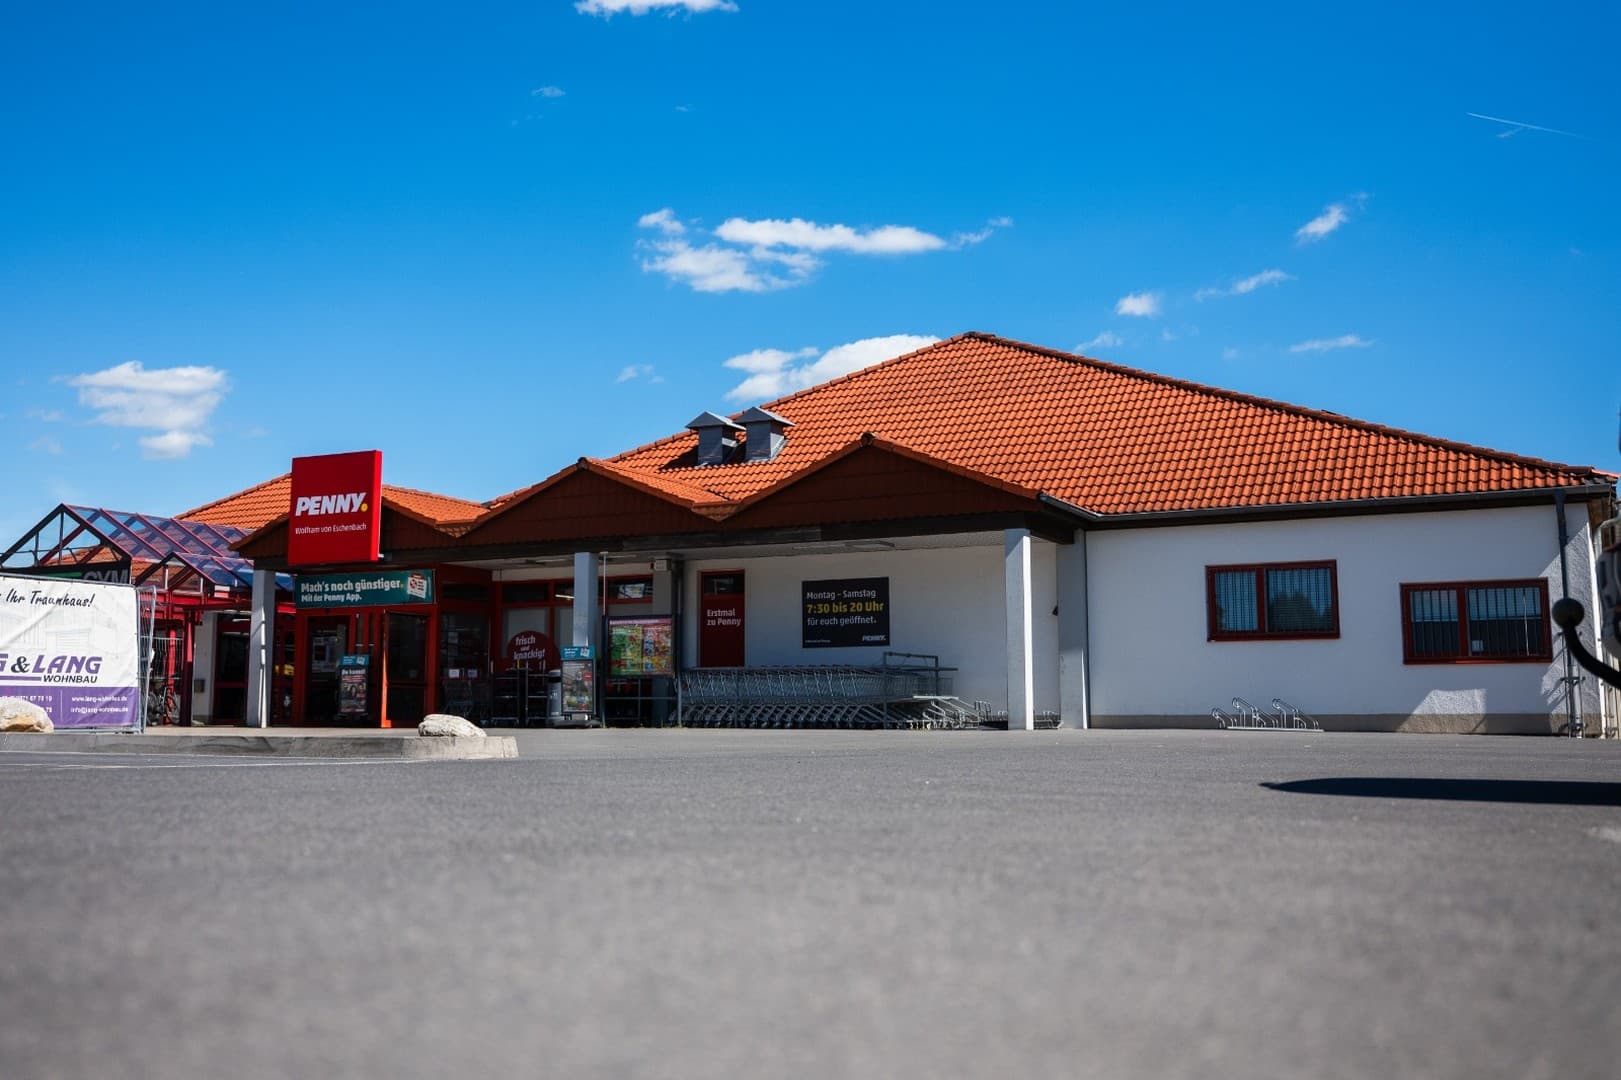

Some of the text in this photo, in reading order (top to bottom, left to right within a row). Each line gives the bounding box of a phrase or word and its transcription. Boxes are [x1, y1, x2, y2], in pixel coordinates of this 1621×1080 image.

[295, 492, 368, 517] PENNY.
[295, 526, 320, 535] Wolfram
[333, 522, 367, 533] Eschenbach
[301, 580, 329, 593] Mach's
[331, 579, 354, 591] noch
[355, 577, 404, 592] günstiger.
[6, 588, 95, 607] Ihr Traumhaus!
[301, 592, 362, 603] Mit der Penny App.
[806, 590, 836, 601] Montag
[842, 589, 877, 600] Samstag
[706, 608, 736, 617] Erstmal
[807, 601, 884, 614] 7:30 bis 20 Uhr
[706, 617, 742, 628] zu Penny
[807, 614, 877, 627] für euch geöffnet.
[515, 634, 536, 646] frisch
[513, 648, 546, 660] knackig!
[10, 656, 30, 673] &
[32, 654, 103, 675] LANG
[43, 675, 98, 684] WOHNBAU
